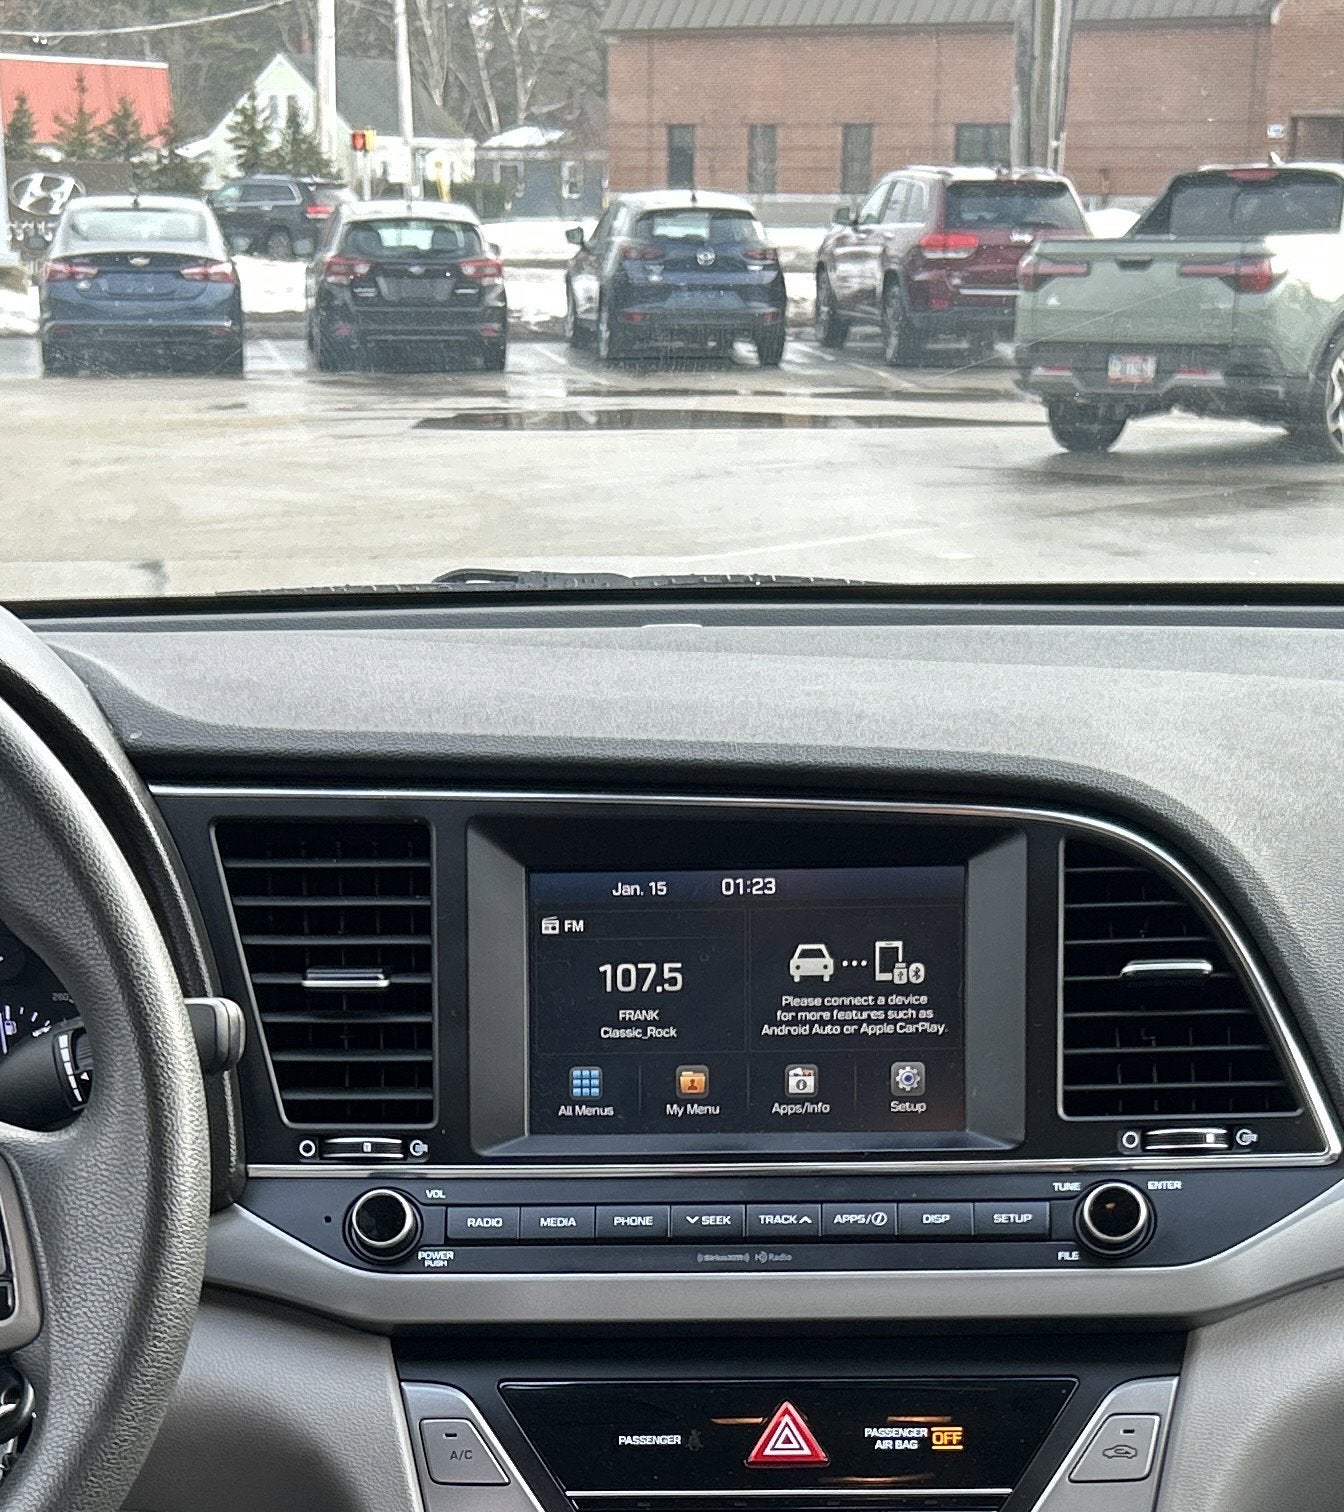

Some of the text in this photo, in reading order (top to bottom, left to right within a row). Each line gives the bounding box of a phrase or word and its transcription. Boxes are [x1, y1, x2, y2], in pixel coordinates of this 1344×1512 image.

[612, 878, 777, 896] Jan. 15 01:23
[564, 920, 585, 932] FM
[598, 962, 683, 993] 107.5
[782, 994, 928, 1007] Please connect a device
[618, 1010, 660, 1021] FRANK
[776, 1009, 934, 1021] for more features such as
[761, 1024, 809, 1035] Android
[812, 1024, 841, 1034] Auto
[843, 1025, 858, 1034] or
[860, 1022, 895, 1036] Apple
[558, 1105, 614, 1116] All Menus
[666, 1103, 720, 1117] My Menu
[771, 1102, 831, 1115] Apps/Info
[890, 1100, 927, 1114] Setup
[1053, 1182, 1082, 1192] TUNE
[1147, 1181, 1184, 1190] ENTER
[425, 1189, 446, 1199] VOL
[467, 1217, 504, 1228] RADIO
[539, 1217, 577, 1227] MEDIA
[613, 1216, 654, 1226] PHONE
[701, 1215, 732, 1225] SEEK
[758, 1214, 798, 1225] TRACK
[922, 1214, 951, 1223] DISP
[993, 1213, 1033, 1223] SETUP
[417, 1251, 455, 1260] POWER
[769, 1252, 793, 1262] Radio
[1057, 1251, 1080, 1261] FILE
[424, 1260, 448, 1268] PUSH
[864, 1427, 929, 1439] PASSENGER
[931, 1431, 963, 1446] OFF
[618, 1435, 682, 1446] PASSENGER
[874, 1439, 919, 1450] AIR BAG
[450, 1449, 473, 1461] A/C
